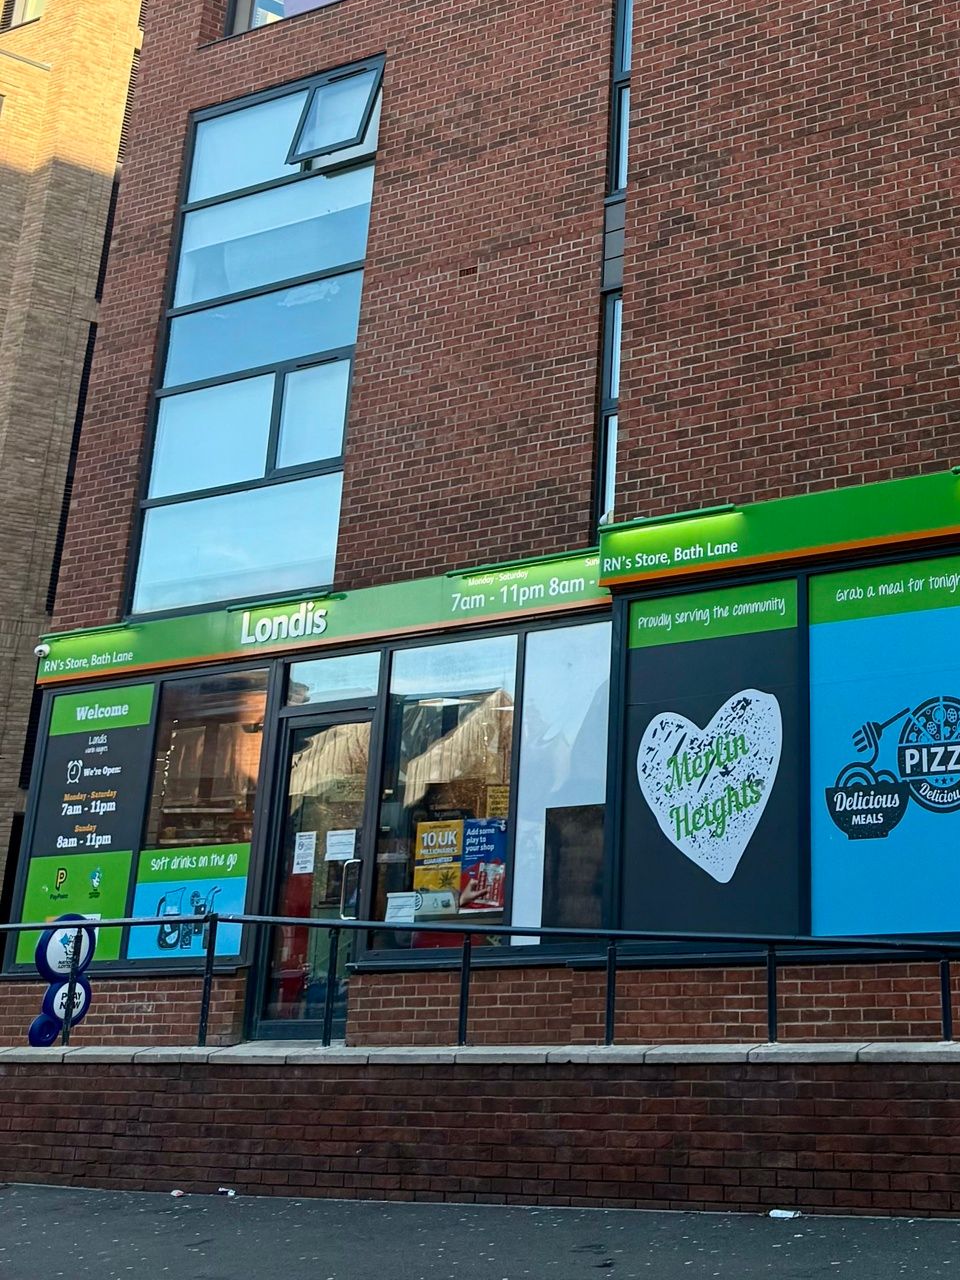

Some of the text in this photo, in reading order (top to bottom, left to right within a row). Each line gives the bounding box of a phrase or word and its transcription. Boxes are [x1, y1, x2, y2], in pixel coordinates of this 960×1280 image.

[635, 552, 671, 567] Store,
[674, 544, 703, 561] Bath
[707, 541, 738, 556] Lane
[468, 575, 495, 586] Monday
[498, 570, 529, 582] Saturday
[451, 593, 485, 612] 7am
[500, 583, 544, 606] 11pm
[549, 577, 585, 596] 8am
[836, 586, 864, 602] Grab
[867, 586, 875, 597] a
[879, 581, 904, 596] meal
[908, 578, 925, 592] for
[638, 597, 785, 631] Proudly serving the community
[240, 601, 328, 644] Londis
[65, 656, 89, 670] Store,
[91, 652, 111, 666] Bath
[112, 651, 133, 663] Lane
[76, 703, 129, 721] Welcome
[664, 731, 750, 793] Merlin
[83, 767, 101, 776] We're
[63, 792, 87, 801] Monday
[90, 789, 117, 799] Saturday
[833, 791, 900, 812] Delicious
[61, 803, 82, 815] 7am
[90, 800, 116, 815] 11pm
[669, 777, 765, 841] Heights
[851, 812, 884, 825] MEALS
[74, 824, 97, 833] Sunday
[466, 827, 495, 836] Add some
[56, 835, 77, 848] 8am
[86, 833, 111, 848] 11pm
[422, 830, 457, 846] 10 UK
[466, 837, 479, 845] play
[480, 844, 494, 852] shop
[171, 855, 196, 869] drinks
[198, 858, 207, 867] on
[210, 853, 224, 866] the
[227, 853, 237, 871] go
[61, 991, 82, 1001] PAY
[59, 1001, 81, 1010] NW
